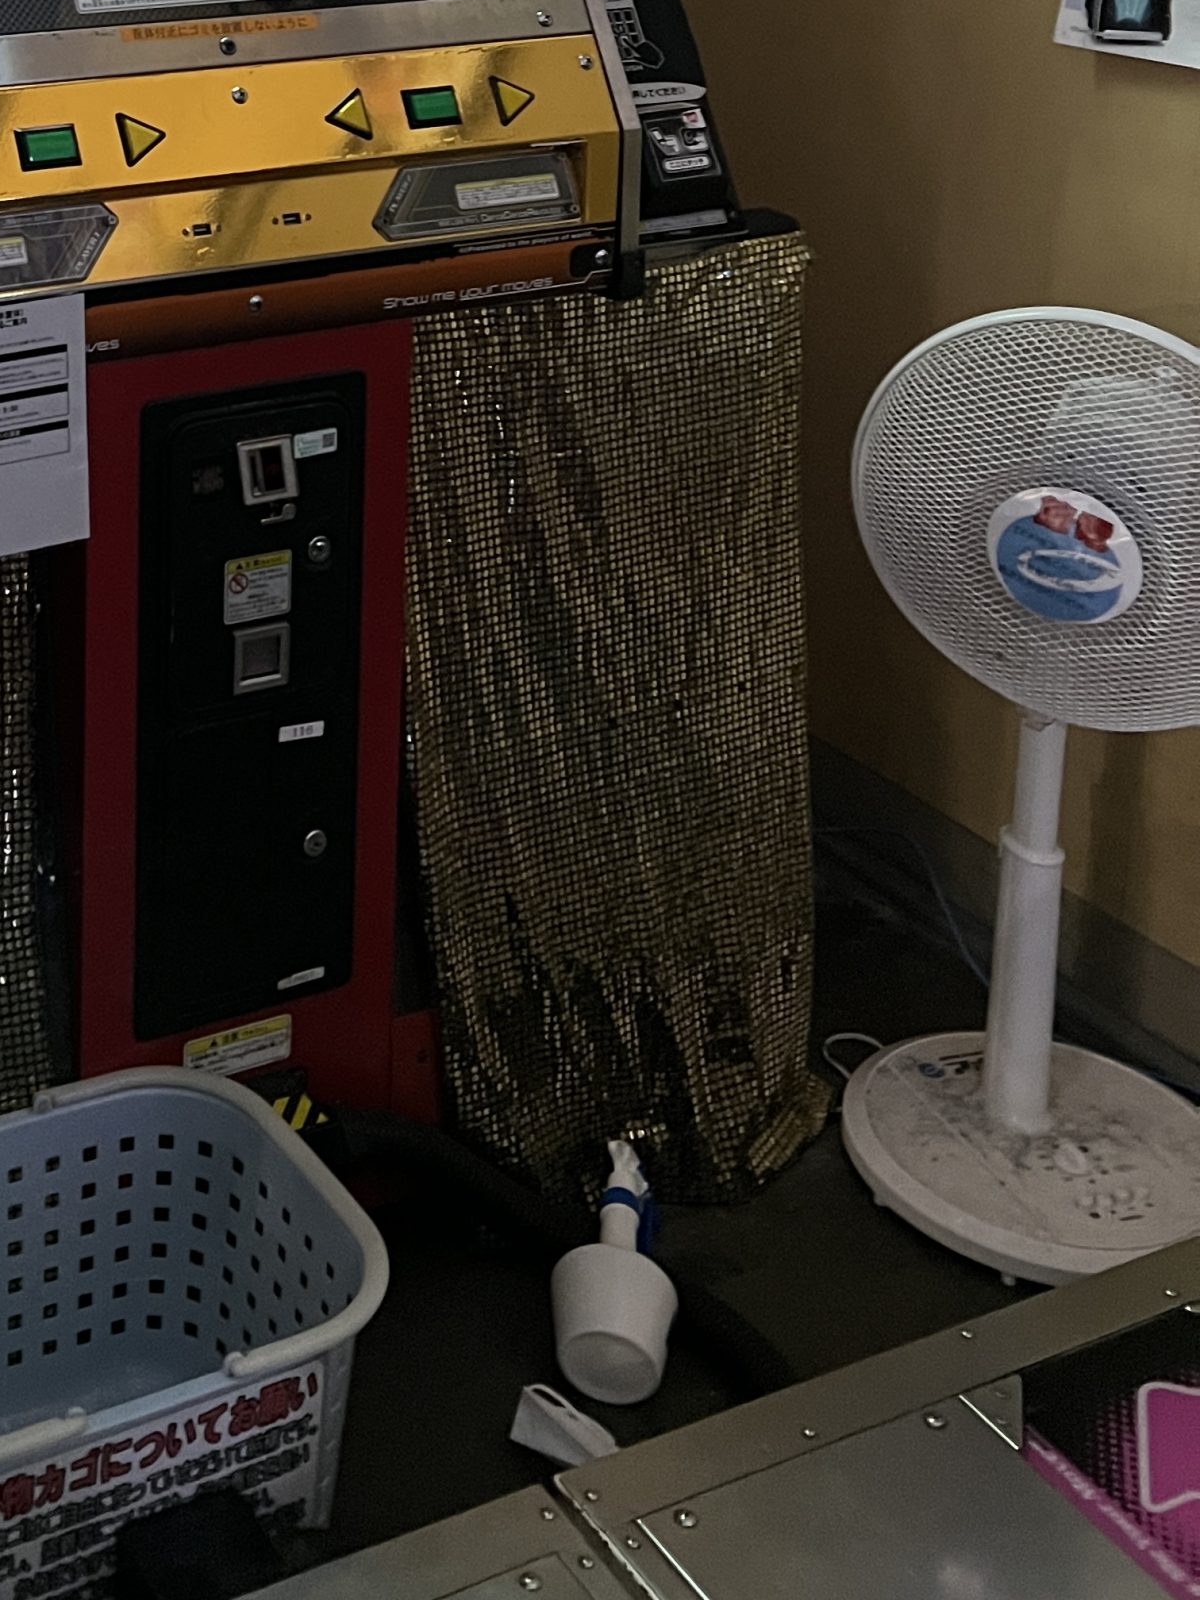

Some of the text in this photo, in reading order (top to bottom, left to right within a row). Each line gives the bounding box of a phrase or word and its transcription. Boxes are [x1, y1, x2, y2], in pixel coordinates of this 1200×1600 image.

[431, 289, 455, 301] me
[459, 284, 500, 299] your
[500, 277, 553, 292] moves
[85, 339, 120, 352] ves
